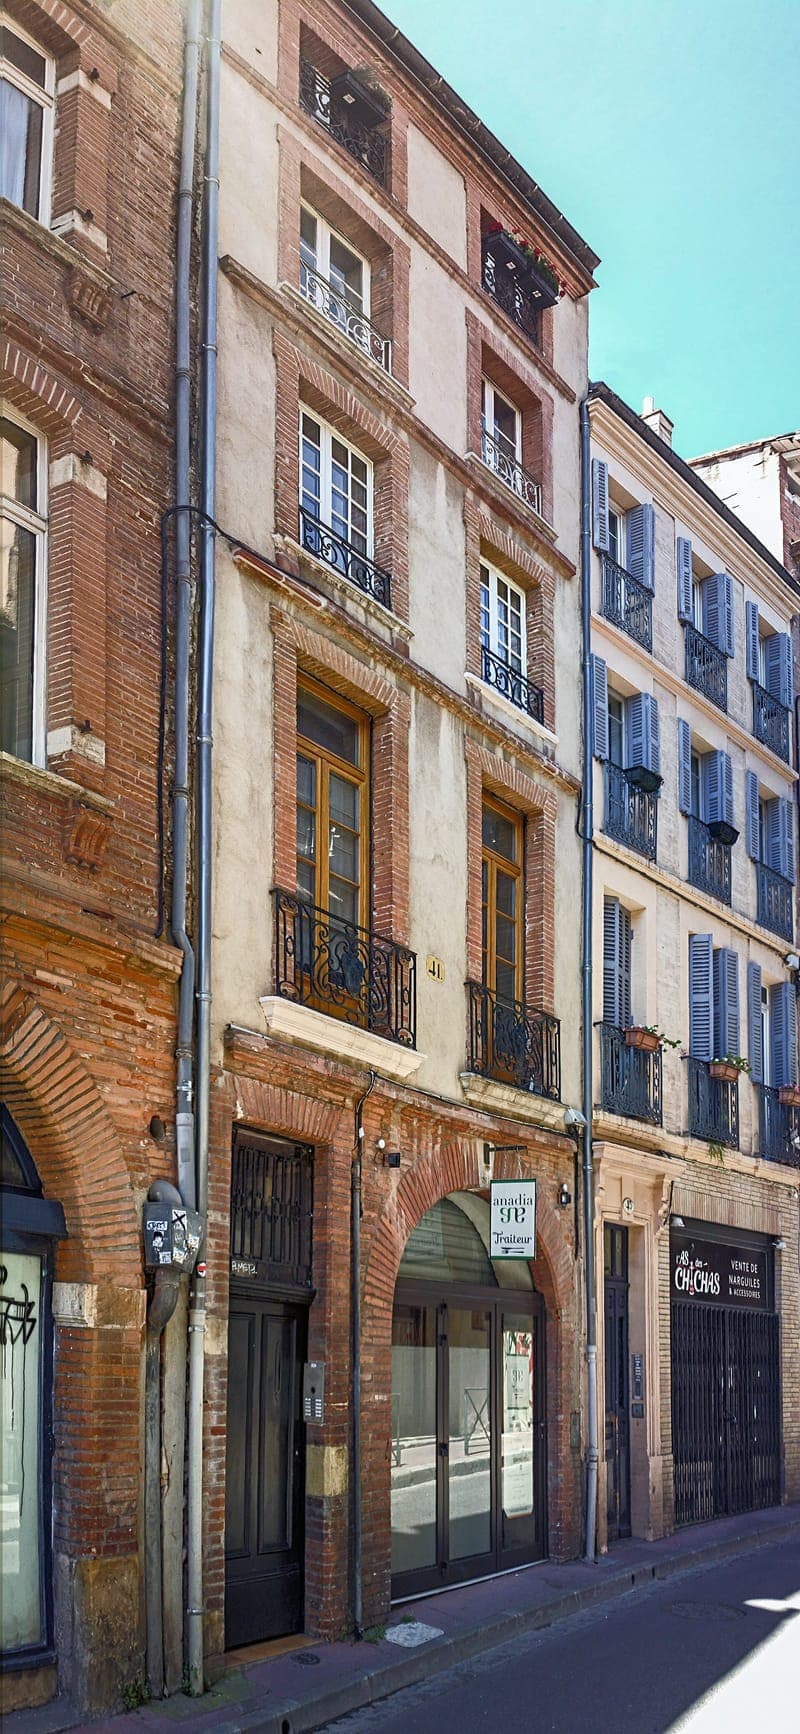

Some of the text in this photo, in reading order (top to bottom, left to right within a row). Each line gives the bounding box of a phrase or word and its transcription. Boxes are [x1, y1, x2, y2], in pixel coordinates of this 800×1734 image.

[493, 1193, 533, 1206] anadia
[492, 1231, 533, 1244] Traiteur
[731, 1259, 758, 1274] VENTE DE
[675, 1266, 721, 1296] CHICHAS
[728, 1274, 761, 1289] NARGUILES
[733, 1288, 761, 1299] ACCESSOIRES
